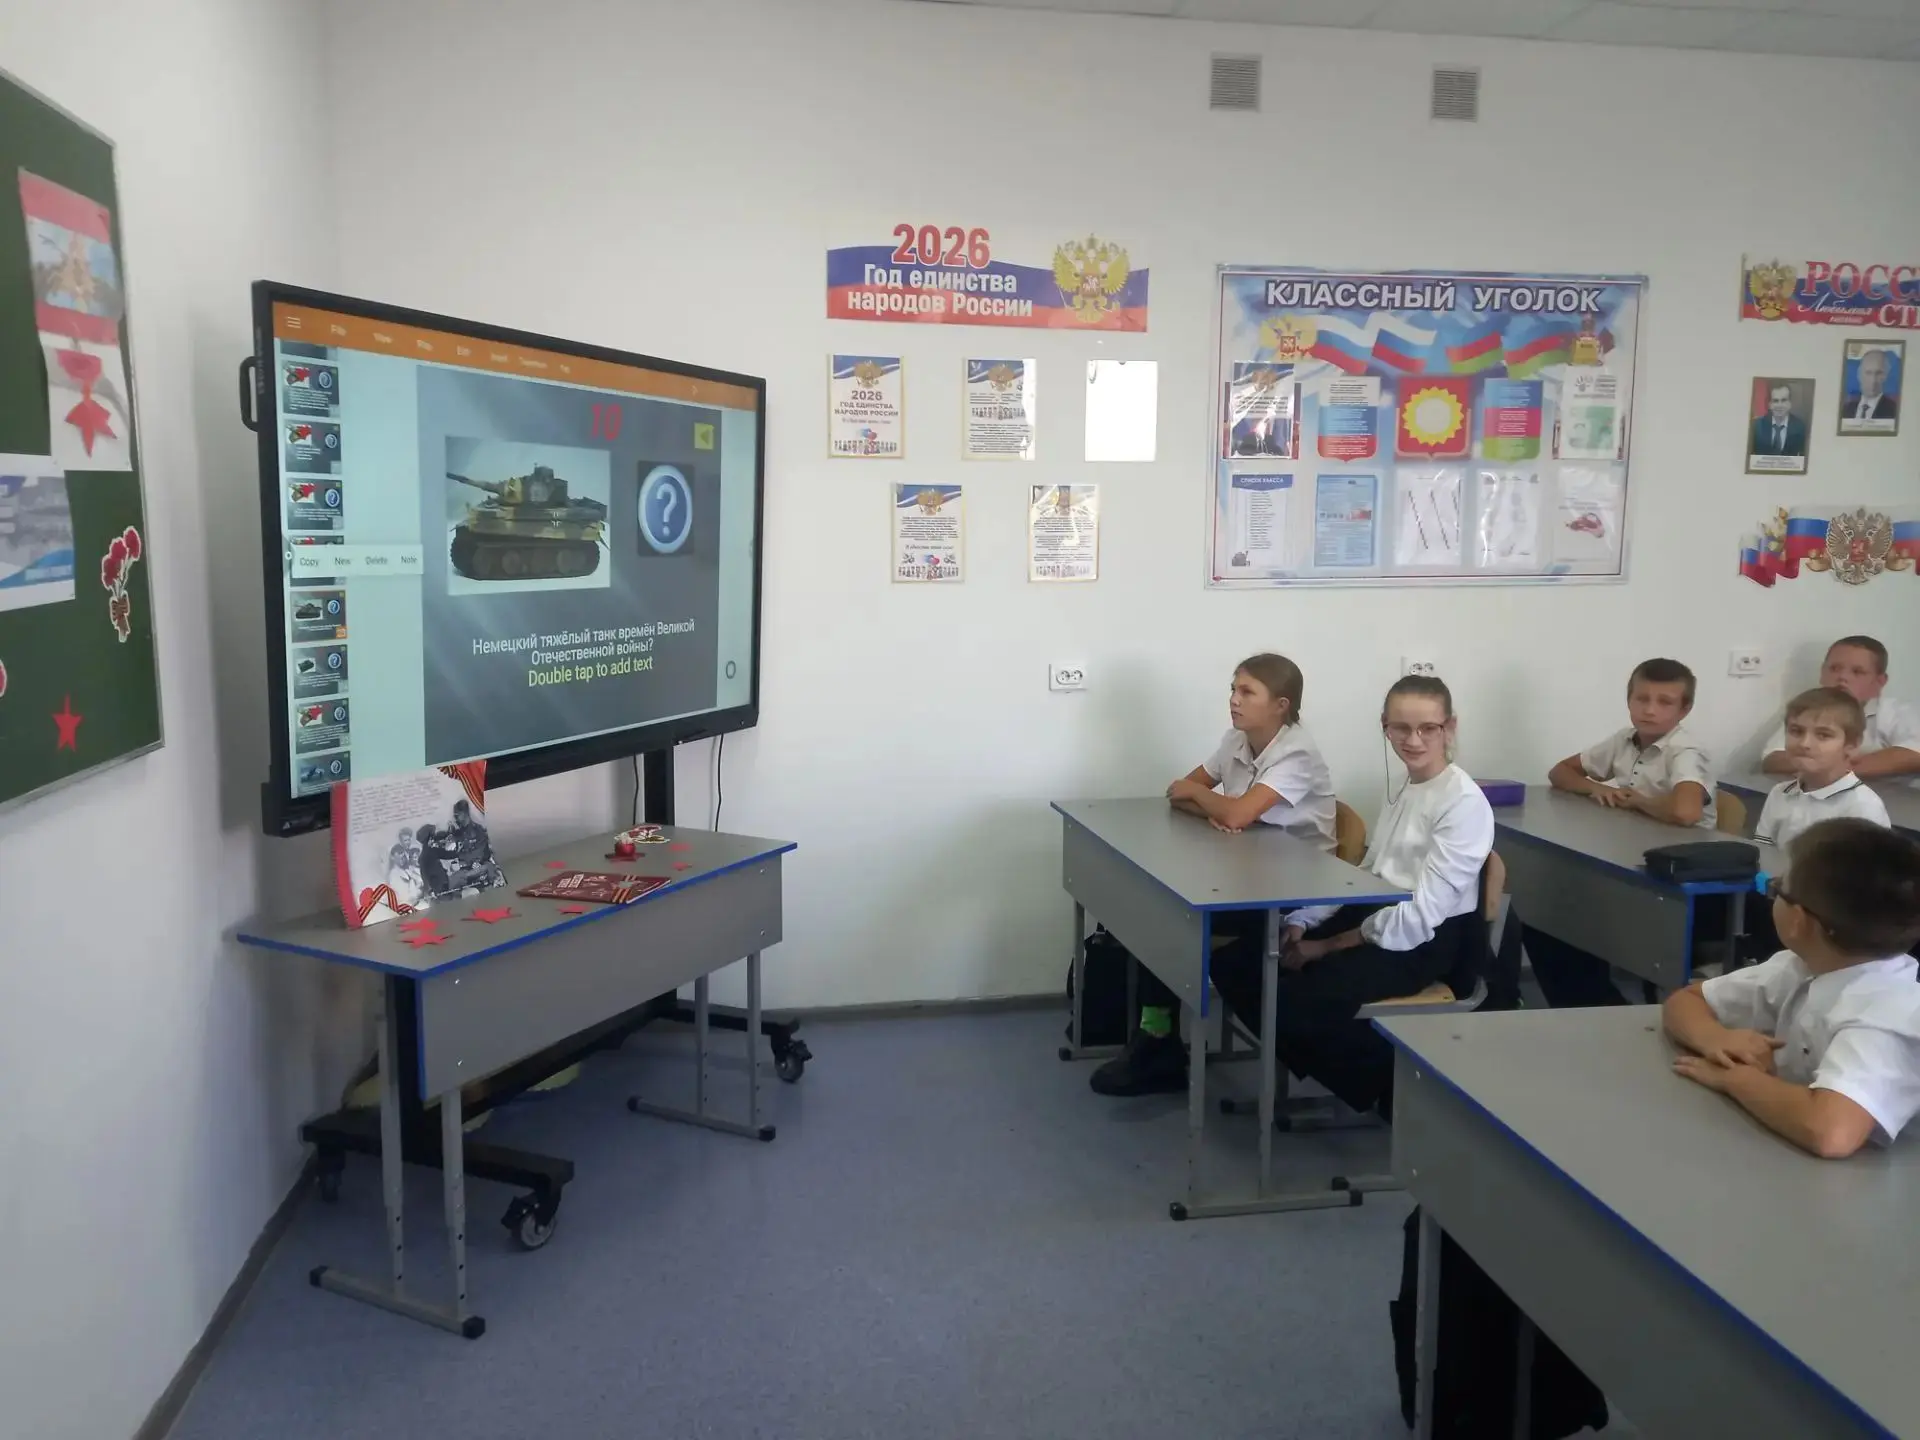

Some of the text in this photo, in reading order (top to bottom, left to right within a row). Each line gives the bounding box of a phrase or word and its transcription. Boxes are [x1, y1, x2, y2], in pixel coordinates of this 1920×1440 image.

[891, 222, 991, 269] 2026
[864, 264, 1017, 293] Год единства
[1800, 261, 1920, 300] РОСС
[848, 291, 1033, 317] народов России
[1266, 281, 1601, 312] КЛАССНЫЙ УГОЛОК
[851, 390, 883, 401] 2026
[590, 402, 623, 442] 10
[299, 557, 319, 568] Copy
[472, 618, 695, 656] Немецкий тяжёлый танк времён Великой
[531, 638, 654, 666] Отечественной войны?
[528, 655, 654, 688] Double tap to add text
